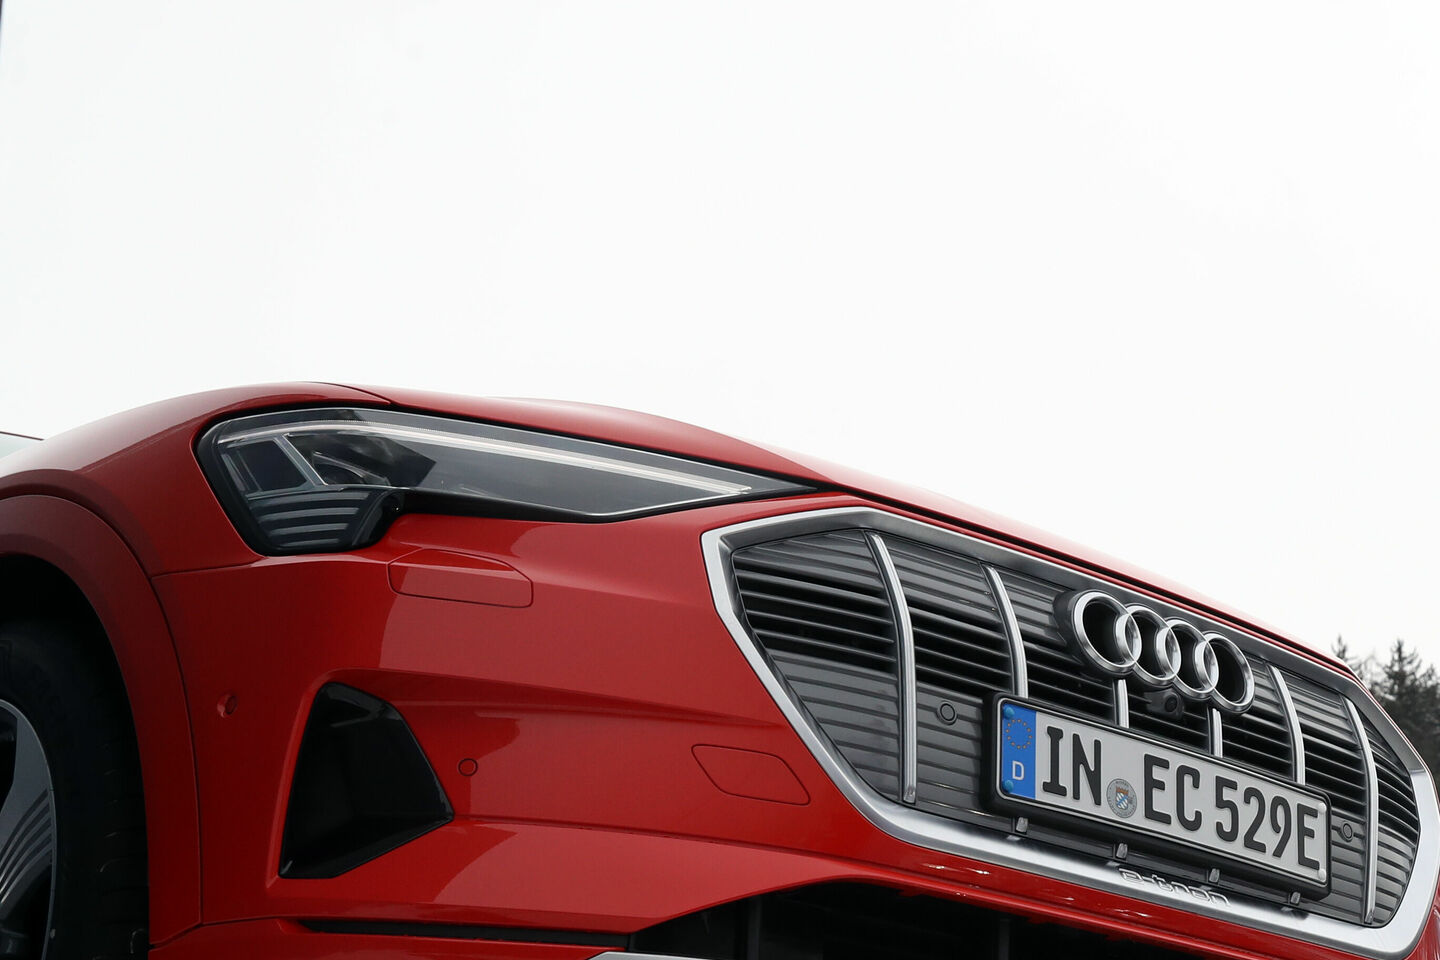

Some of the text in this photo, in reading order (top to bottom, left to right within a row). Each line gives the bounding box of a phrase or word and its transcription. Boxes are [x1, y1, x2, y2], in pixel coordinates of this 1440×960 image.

[1012, 760, 1025, 781] D
[1042, 725, 1102, 806] IN
[1143, 753, 1203, 832] EC
[1215, 775, 1321, 871] 529E
